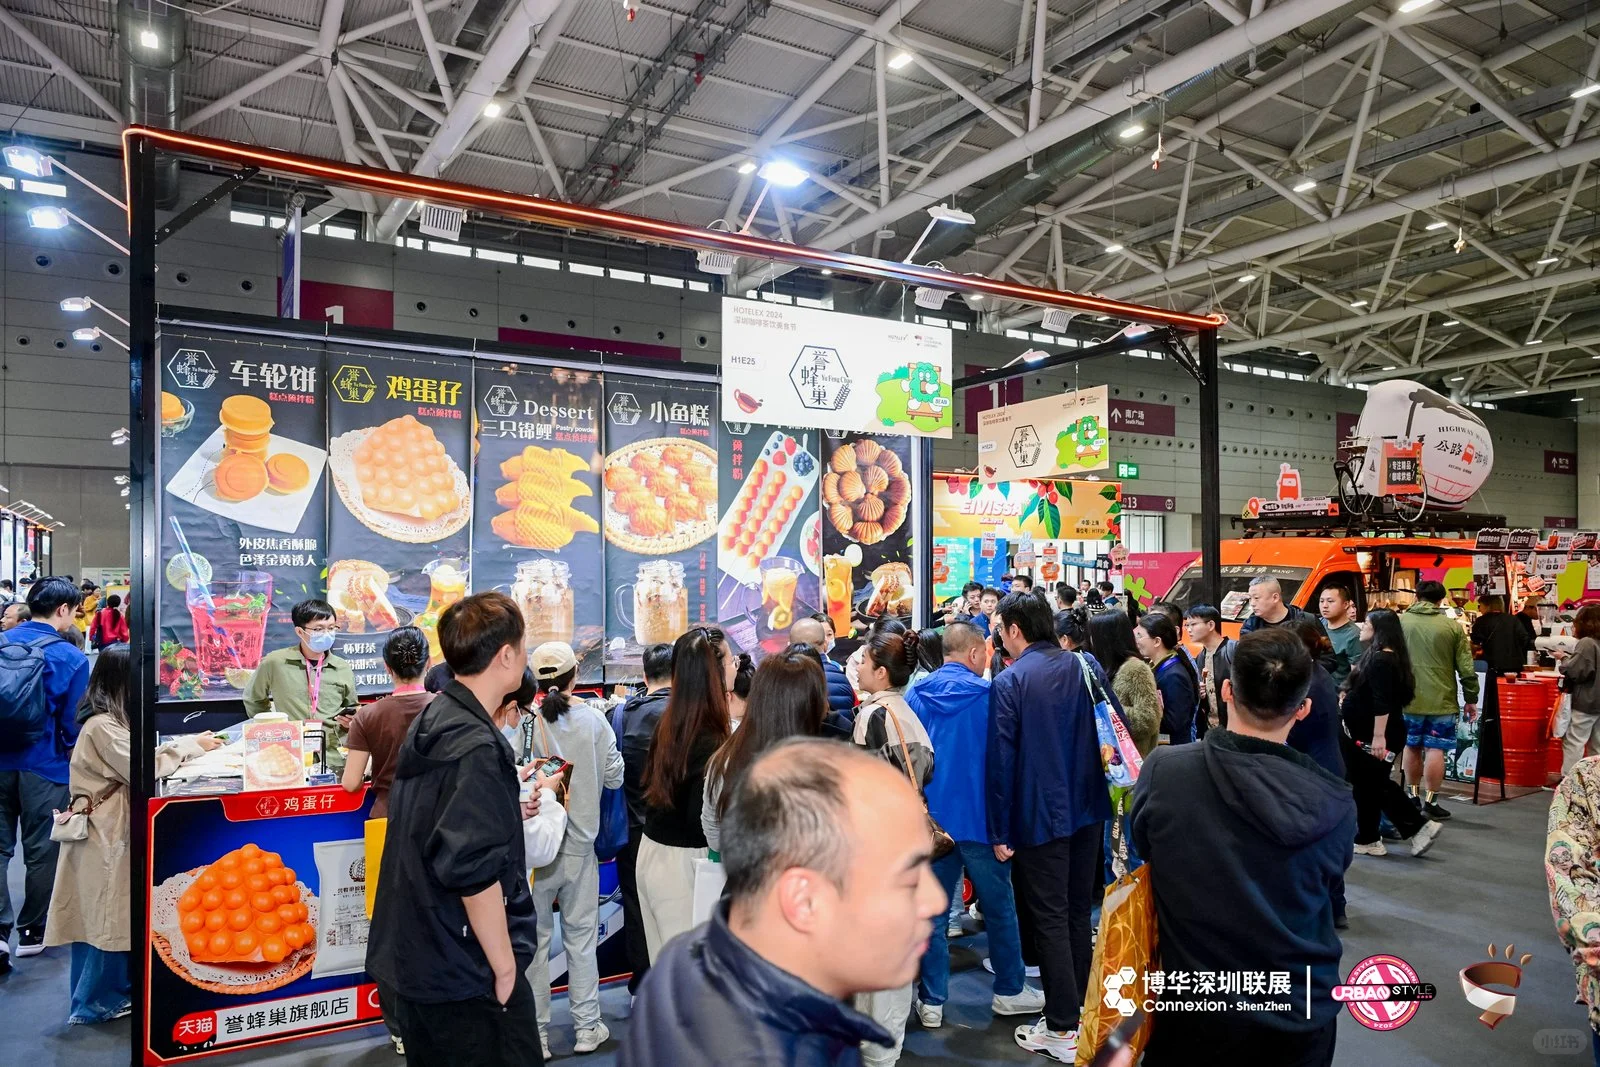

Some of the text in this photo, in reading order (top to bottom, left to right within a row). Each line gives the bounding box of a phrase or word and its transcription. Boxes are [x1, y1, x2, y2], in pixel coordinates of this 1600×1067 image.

[733, 305, 783, 319] HOTELEX 2024
[731, 355, 756, 366] H1E25
[229, 360, 317, 393] 车轮饼
[386, 375, 463, 406] 鸡蛋仔
[989, 382, 998, 409] 1
[523, 399, 594, 420] Dessert
[649, 401, 710, 426] 小鱼糕
[1125, 409, 1145, 420] 南广场
[481, 419, 552, 440] 三只锦鲤
[556, 425, 573, 433] Pastry
[1438, 426, 1474, 436] HIGHWAY
[1434, 440, 1462, 456] 公路
[1128, 497, 1137, 508] 13
[239, 537, 317, 551] 外皮焦香酥脆
[240, 553, 317, 566] 色泽金黄诱人
[332, 643, 376, 655] 一杯好茶
[284, 794, 335, 812] 鸡蛋仔
[225, 997, 349, 1034] 誉蜂巢旗舰店
[179, 1016, 213, 1037] 天猫
